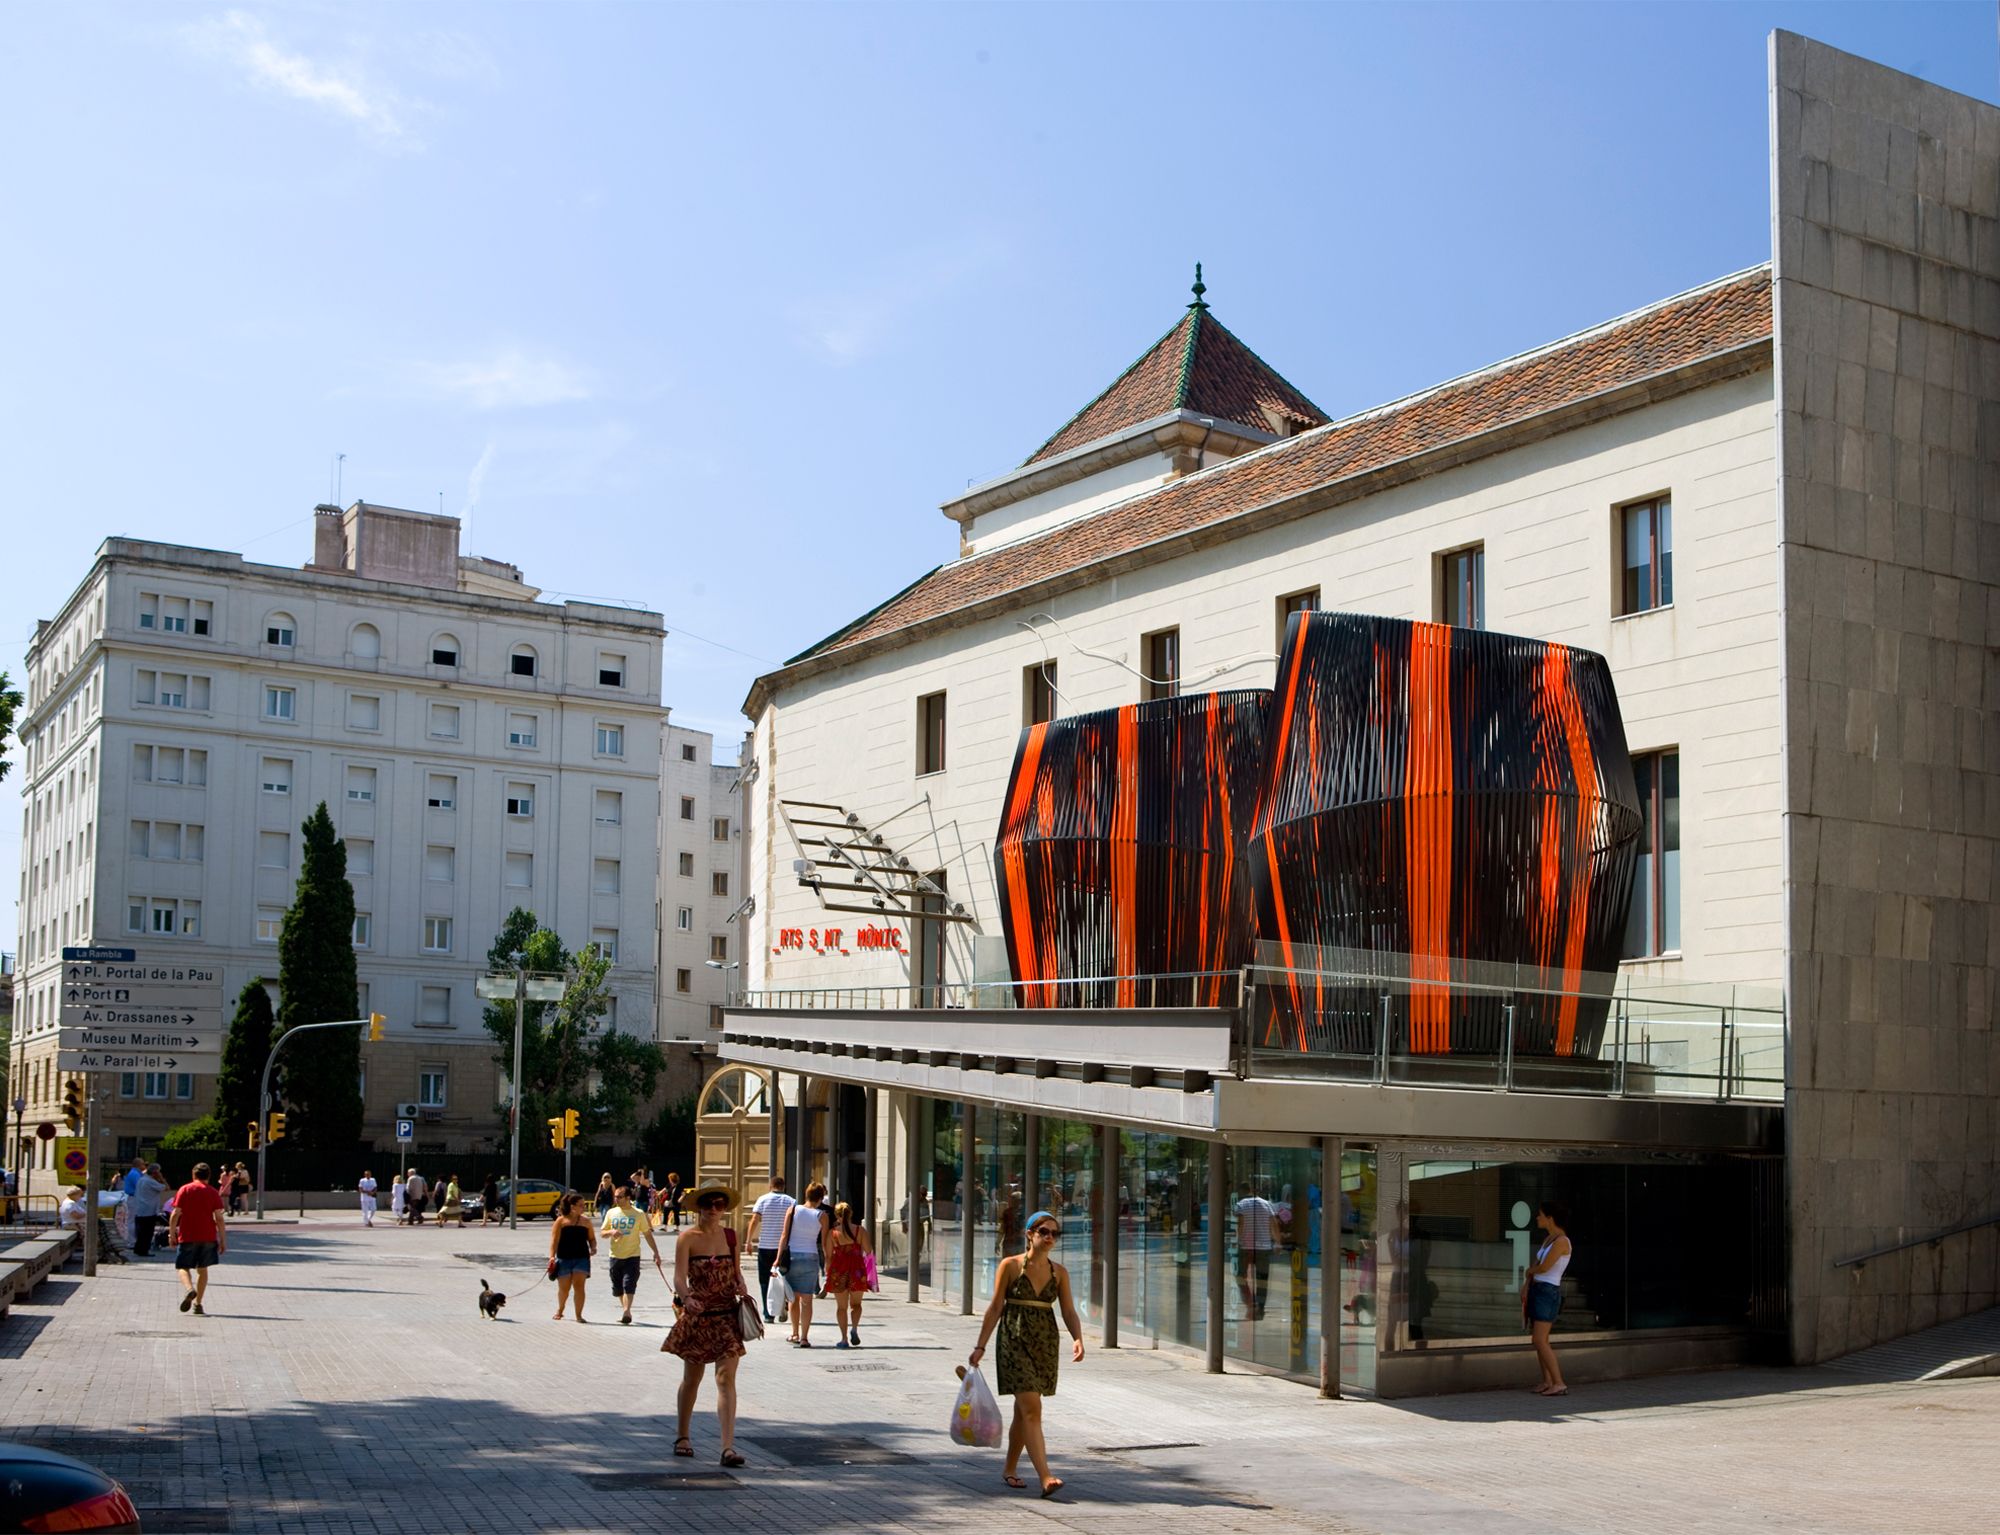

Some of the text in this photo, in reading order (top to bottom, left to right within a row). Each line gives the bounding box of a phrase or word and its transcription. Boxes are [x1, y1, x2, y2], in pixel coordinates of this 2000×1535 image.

[76, 949, 122, 959] La Rambla
[84, 966, 213, 981] Pl. Portal de la Pau
[83, 988, 111, 1000] Port
[83, 1010, 177, 1024] Av. Drassanes
[81, 1032, 182, 1047] Museu Marítim
[80, 1054, 160, 1067] Av. Paral·lel
[400, 1122, 410, 1136] P
[1504, 1200, 1532, 1293] i
[1228, 1191, 1239, 1348] Literatura
[1290, 1249, 1301, 1357] Teatre
